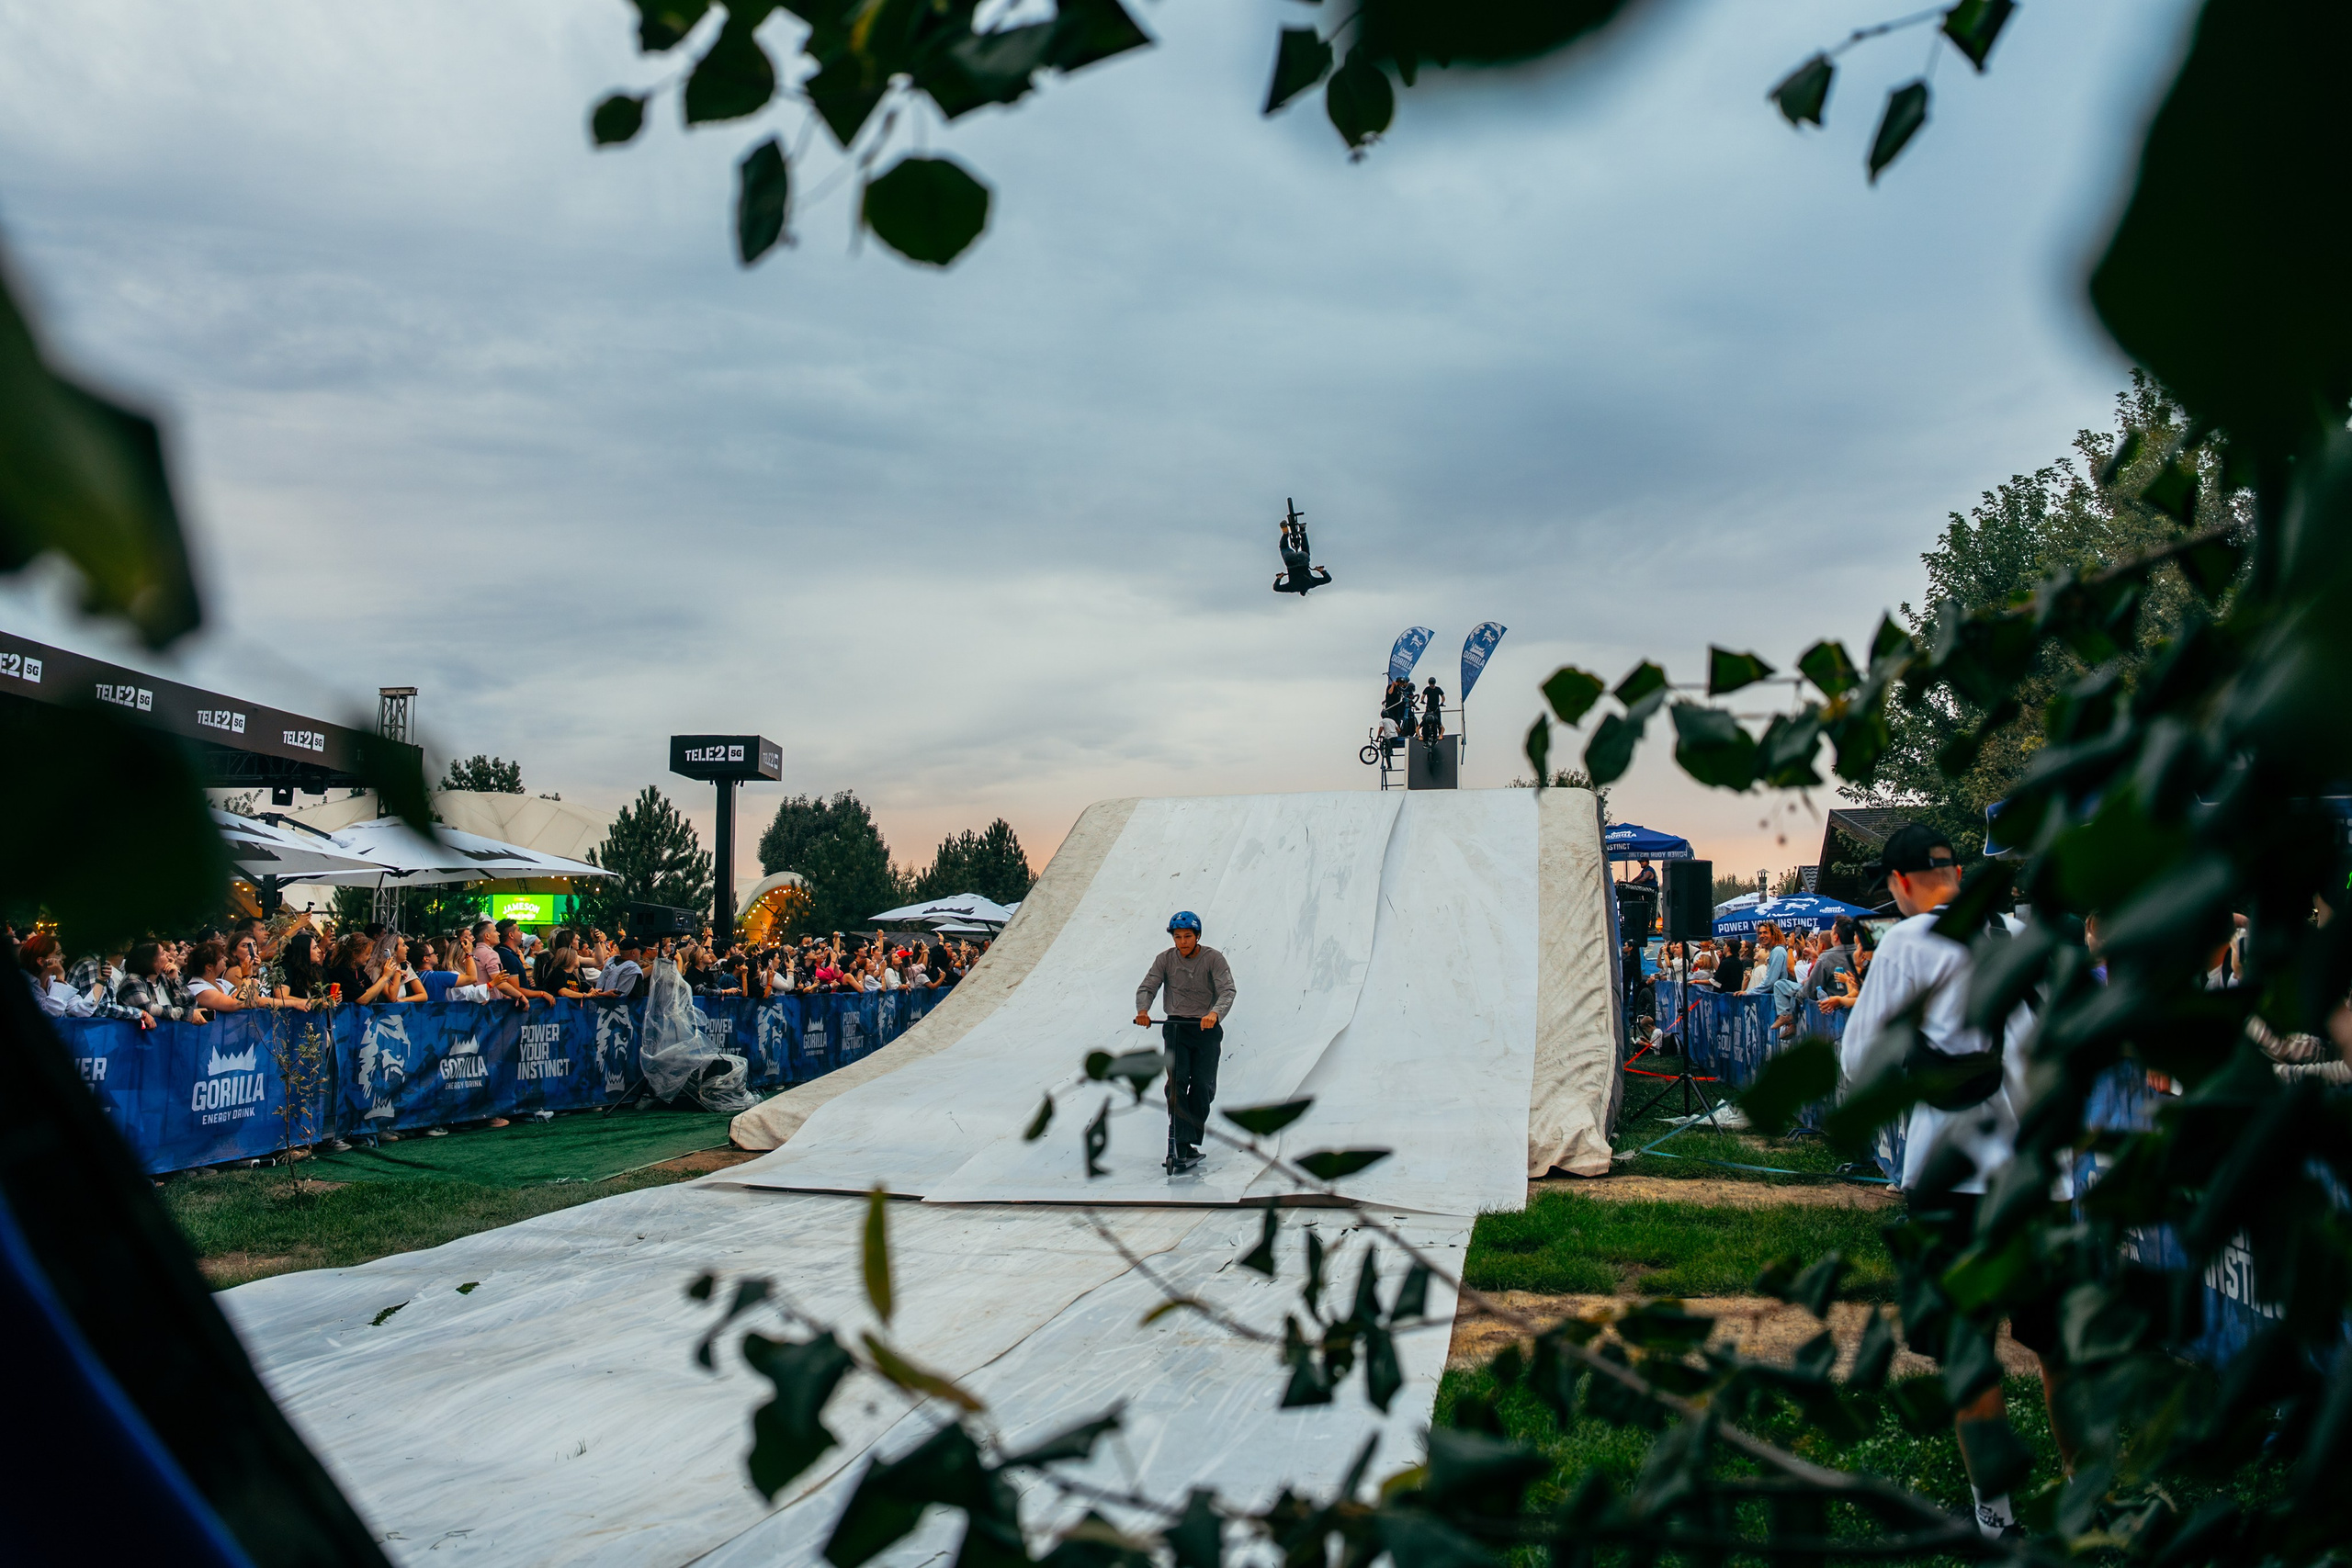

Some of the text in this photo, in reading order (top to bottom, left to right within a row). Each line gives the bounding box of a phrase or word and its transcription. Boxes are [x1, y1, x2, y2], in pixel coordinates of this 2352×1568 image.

[1391, 654, 1414, 671] GORILLA
[1463, 650, 1486, 668] GORILLA
[26, 663, 40, 676] 5G
[96, 683, 151, 707] TELE2 5G
[197, 710, 243, 730] TELE2 5G
[283, 730, 323, 750] TELE2 5G
[684, 745, 742, 761] TELE2 5G
[1606, 843, 1631, 852] NSTINCT
[503, 902, 541, 915] JAMESON
[1718, 921, 1749, 934] POWER
[1777, 917, 1819, 929] INSTINCT
[520, 1023, 560, 1043] POWER
[705, 1018, 733, 1033] POWER
[707, 1032, 726, 1048] OUR
[803, 1032, 828, 1050] GORILLA
[519, 1042, 549, 1062] YOUR
[439, 1055, 489, 1080] GORILLA
[517, 1058, 571, 1080] INSTINCT
[191, 1072, 266, 1112] GORILLA
[465, 1079, 483, 1089] DRINK
[202, 1107, 255, 1125] ENERGY DRINK
